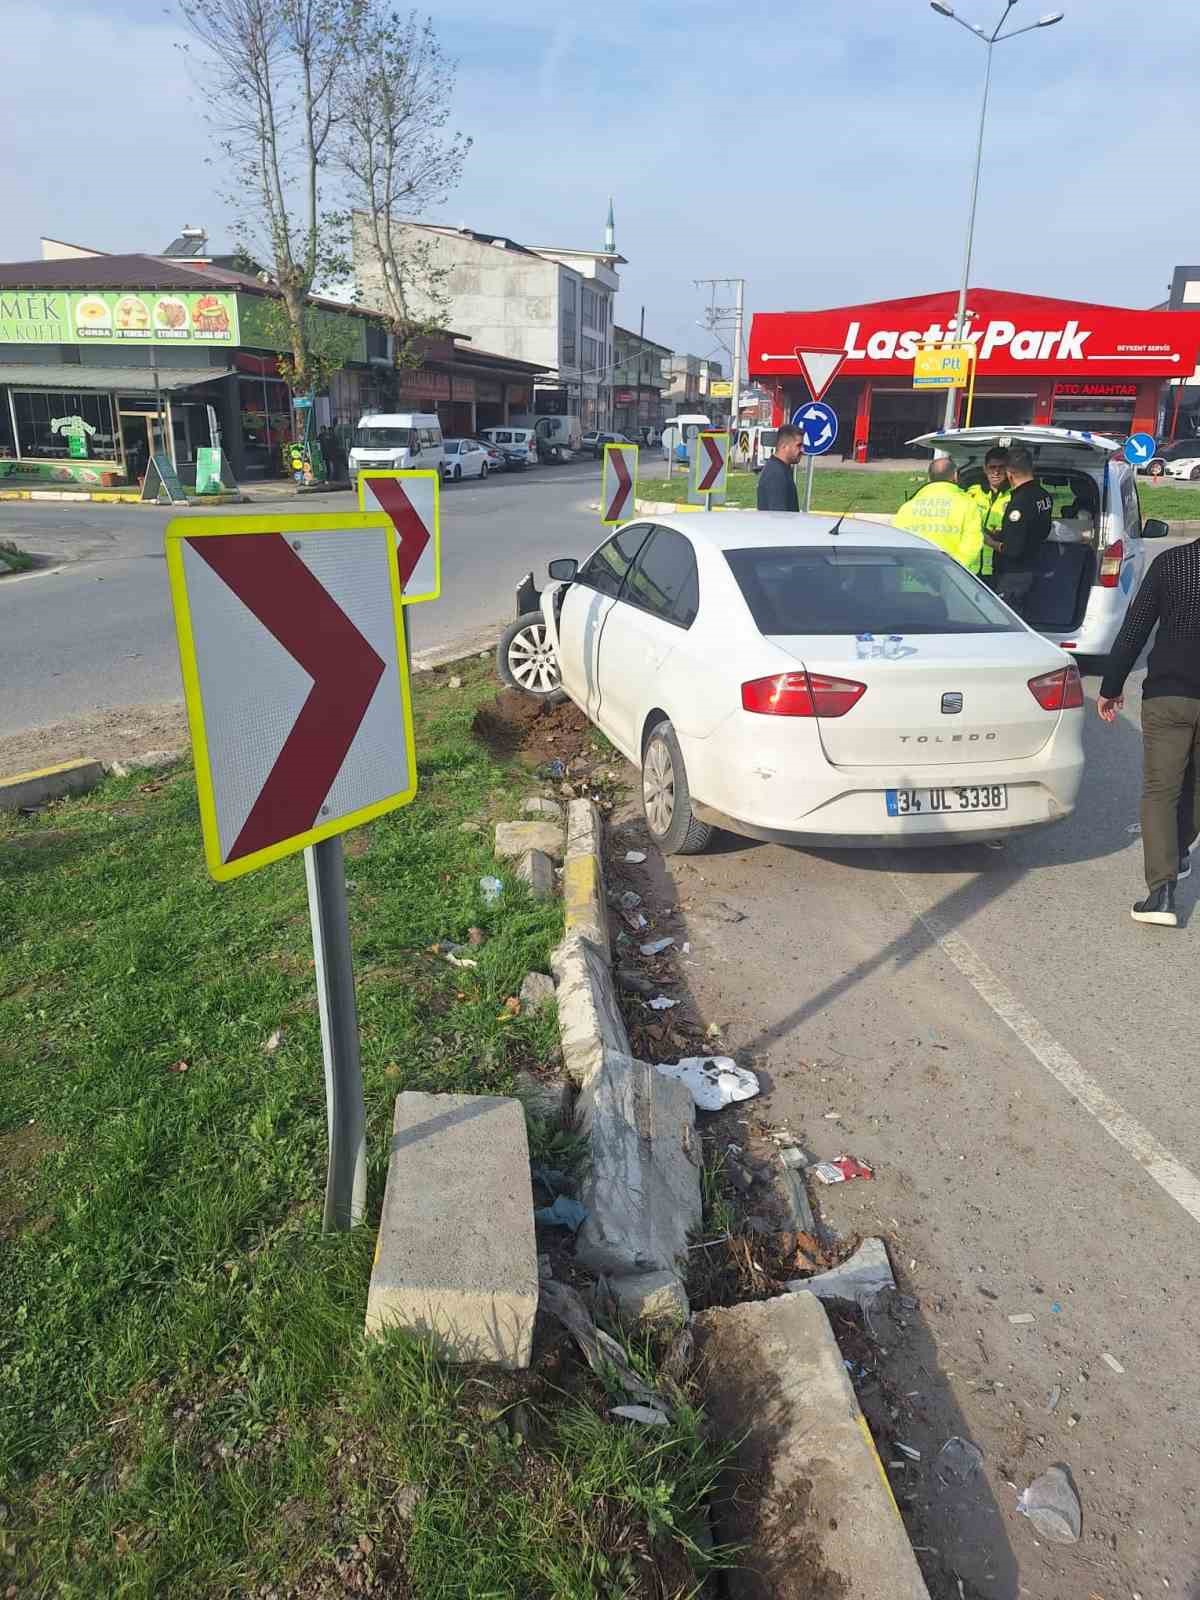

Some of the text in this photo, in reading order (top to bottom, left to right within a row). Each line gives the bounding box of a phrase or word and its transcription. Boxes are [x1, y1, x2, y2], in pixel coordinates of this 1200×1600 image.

[0, 297, 61, 321] MEK
[1081, 384, 1137, 396] ANAHTAR
[899, 732, 997, 743] TOLEDO
[899, 790, 921, 812] 34
[930, 788, 951, 810] UL
[959, 786, 1002, 809] 5338
